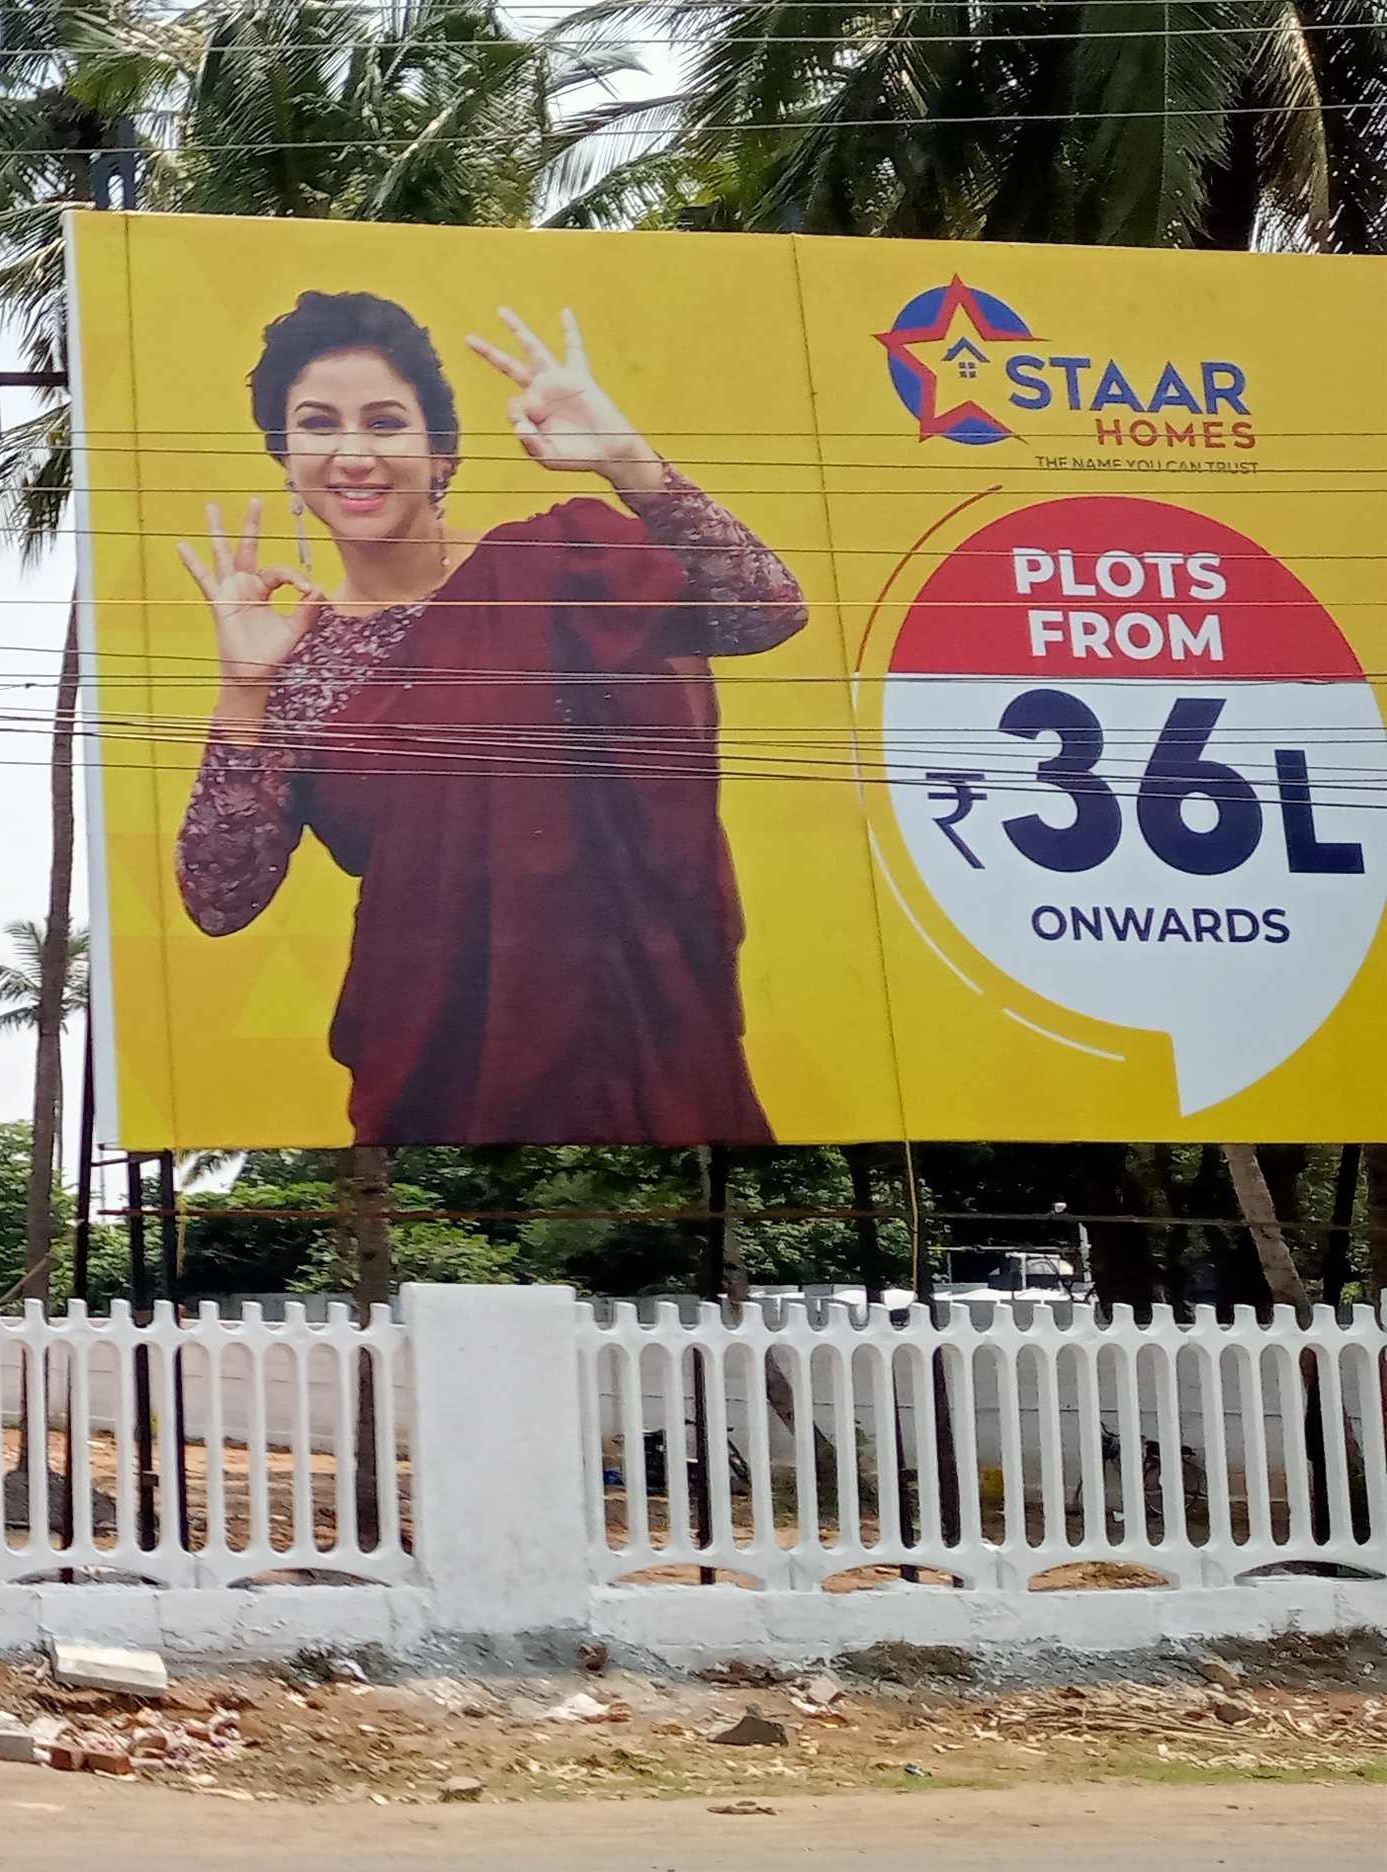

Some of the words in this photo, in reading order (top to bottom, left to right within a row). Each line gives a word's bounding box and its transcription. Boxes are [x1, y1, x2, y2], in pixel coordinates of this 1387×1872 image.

[1005, 354, 1252, 416] STAAR
[1094, 417, 1257, 450] HOMES
[1035, 455, 1068, 471] THE
[1072, 456, 1122, 472] NAME
[1125, 458, 1162, 473] YOU
[1163, 459, 1202, 474] CAN
[1204, 460, 1259, 475] TRUST
[1012, 546, 1227, 601] PLOTS
[1027, 609, 1225, 662] FROM
[1031, 904, 1290, 944] ONWARDS
